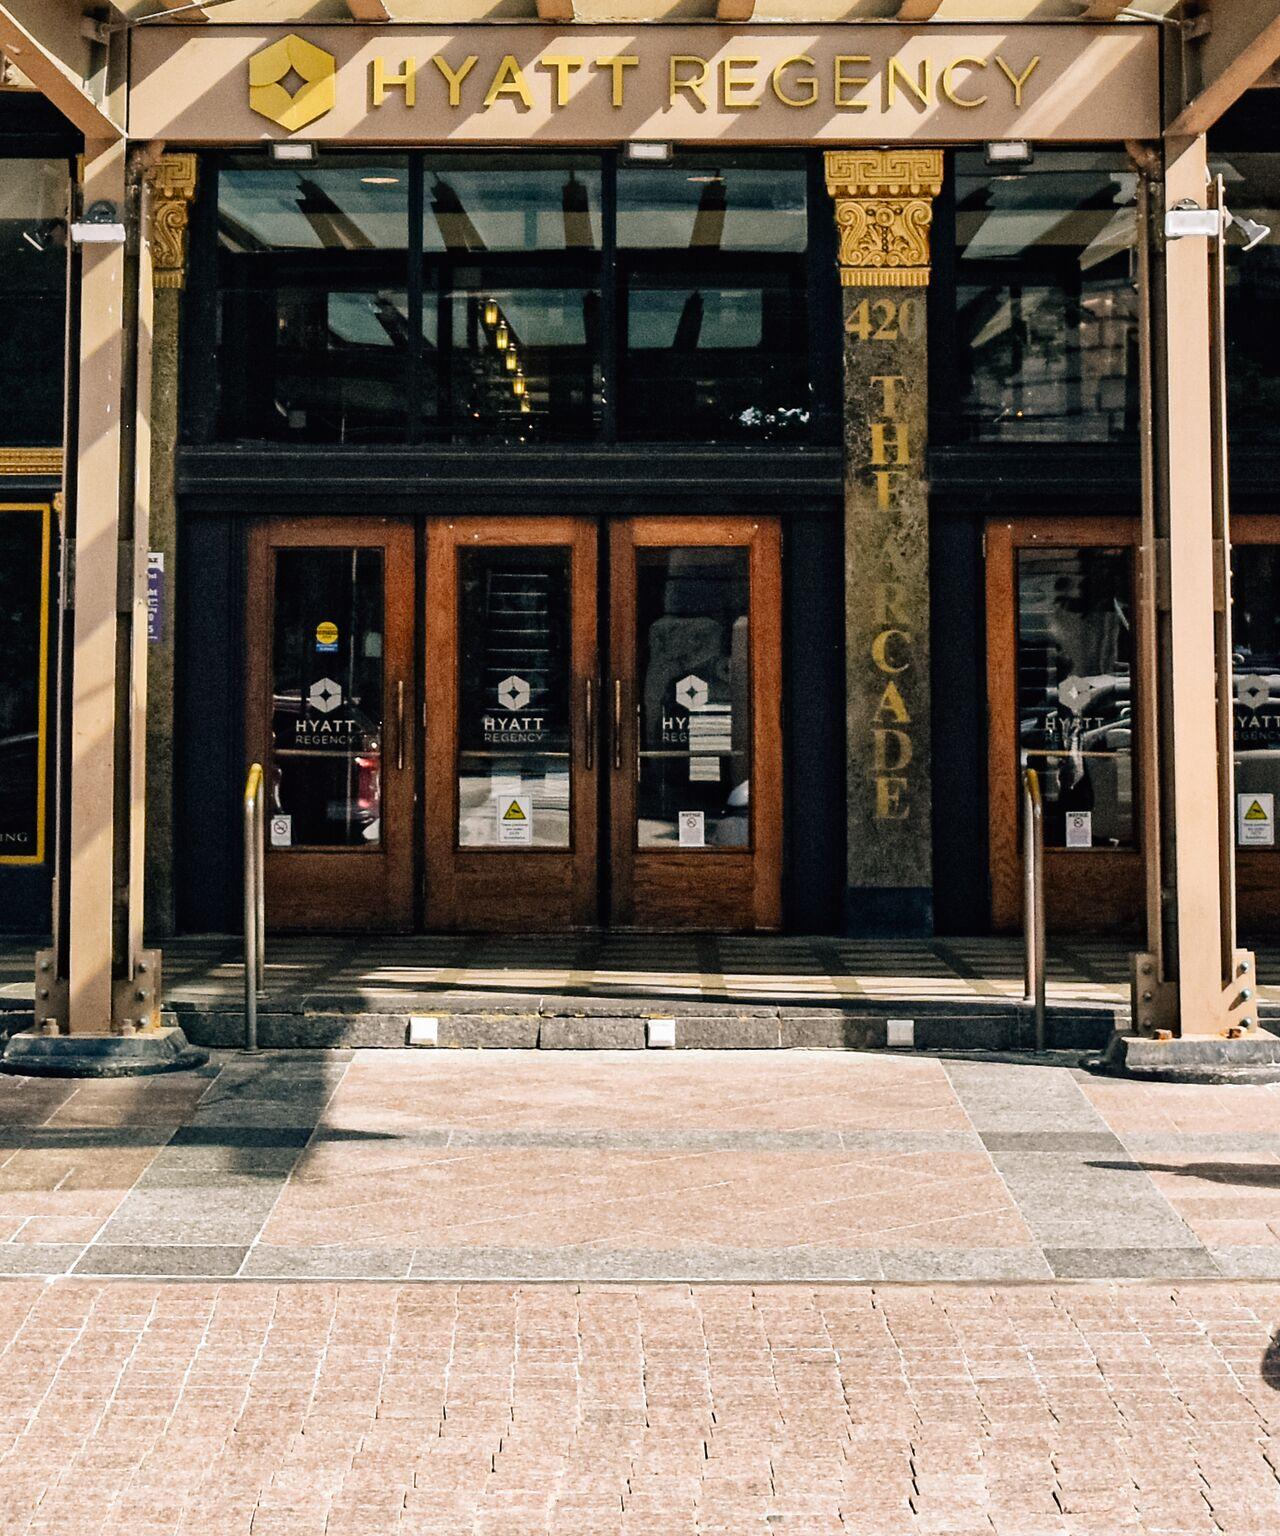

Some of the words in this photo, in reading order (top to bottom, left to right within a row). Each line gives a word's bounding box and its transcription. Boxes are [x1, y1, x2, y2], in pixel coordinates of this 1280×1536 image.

[373, 55, 639, 106] HYATT
[670, 55, 1039, 107] REGENCY
[844, 298, 924, 341] 420
[295, 720, 356, 732] HYATT
[484, 718, 544, 731] HYATT
[295, 735, 354, 745] REGENCY
[484, 733, 544, 742] REGENCY
